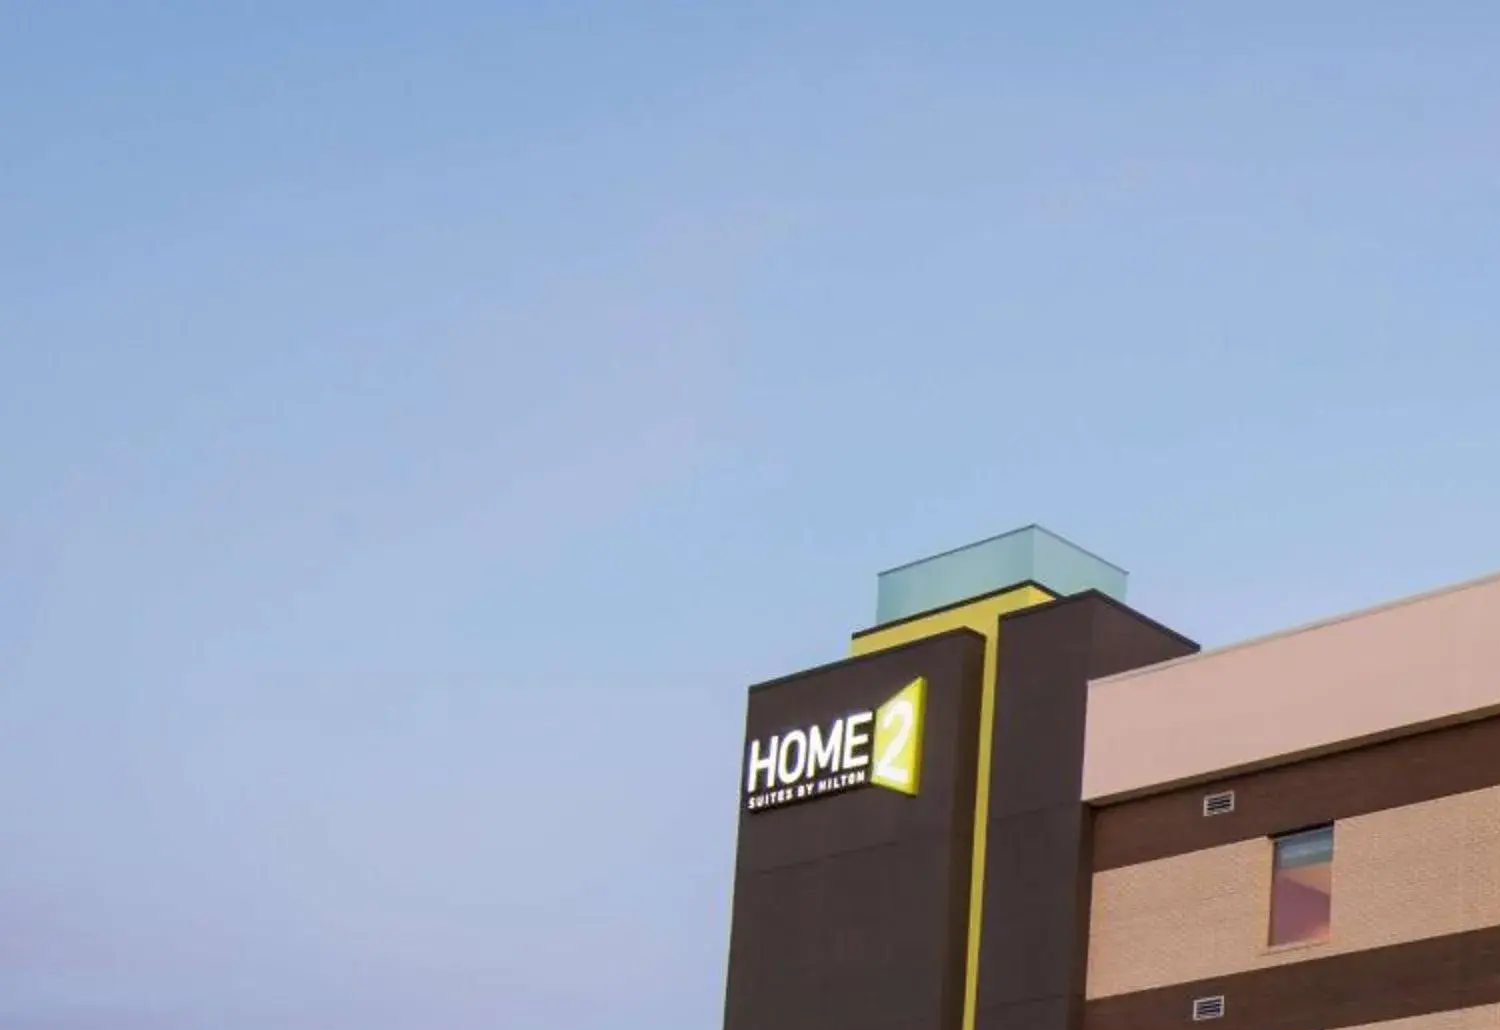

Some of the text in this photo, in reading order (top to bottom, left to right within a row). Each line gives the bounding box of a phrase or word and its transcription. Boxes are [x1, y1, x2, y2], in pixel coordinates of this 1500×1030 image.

[748, 770, 866, 810] SUITES BY HILTON
